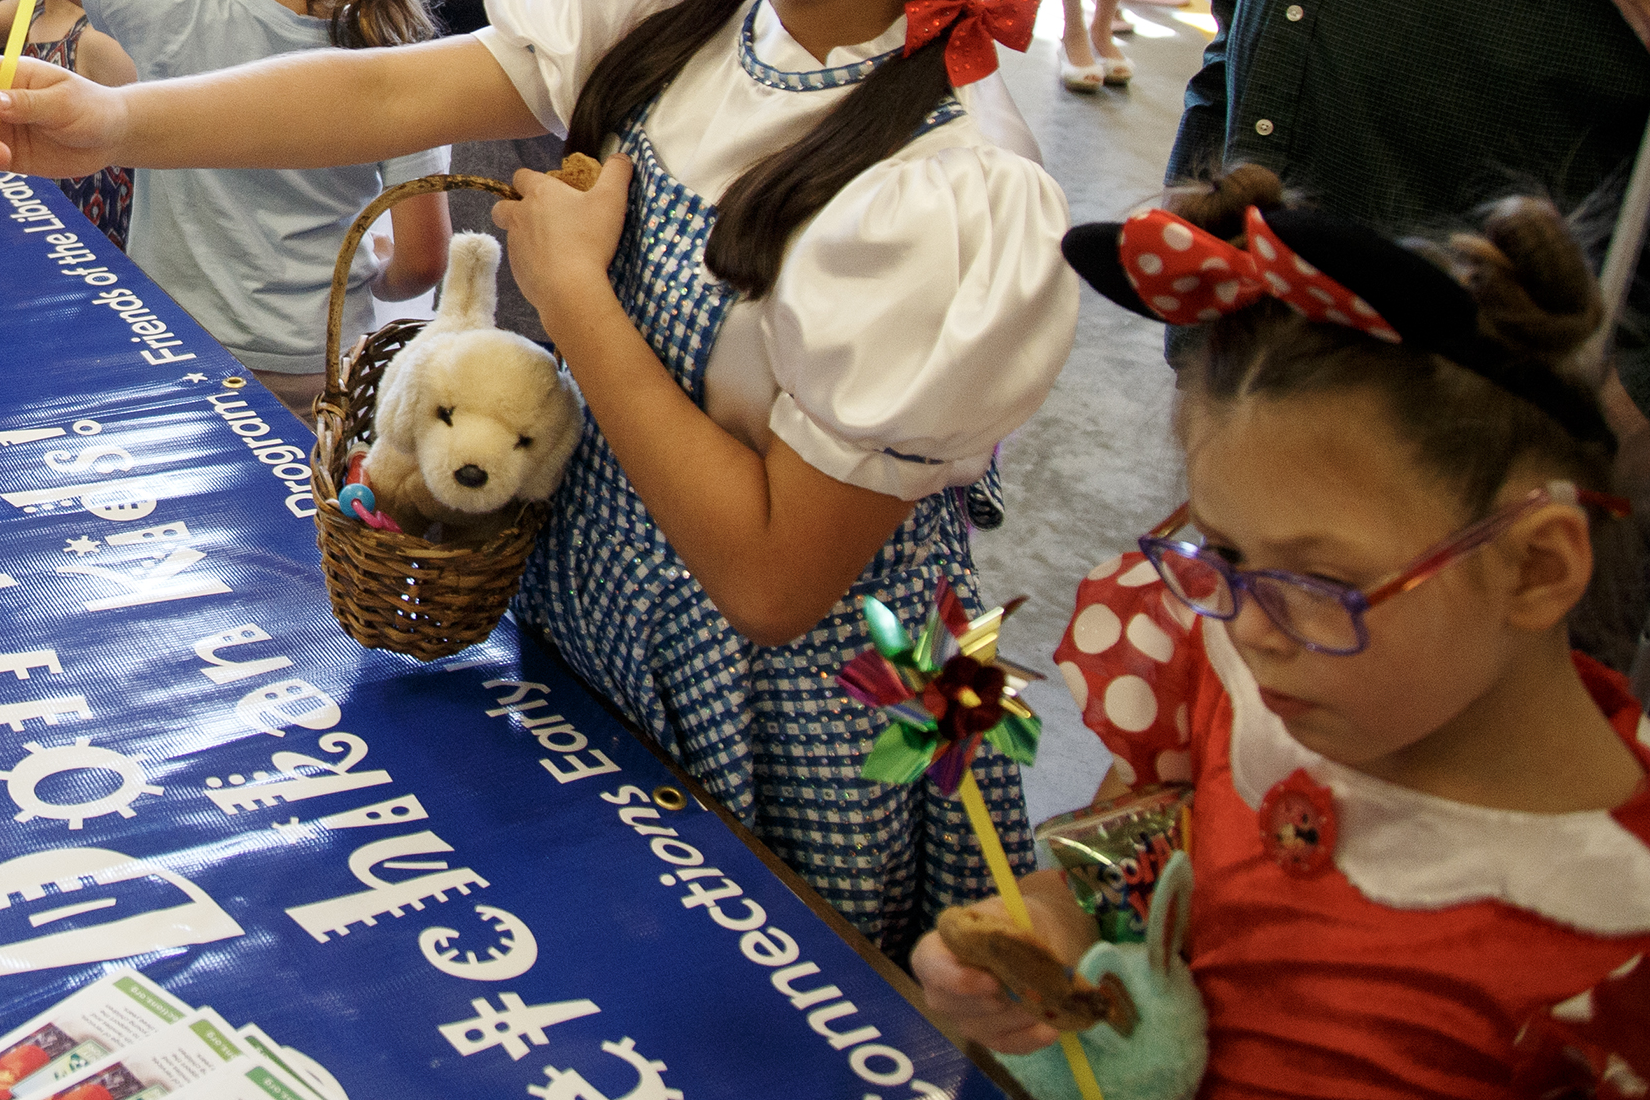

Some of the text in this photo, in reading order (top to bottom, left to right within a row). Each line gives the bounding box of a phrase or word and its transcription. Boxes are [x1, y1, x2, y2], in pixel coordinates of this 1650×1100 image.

[46, 232, 96, 265] the
[61, 266, 118, 286] of
[92, 288, 197, 365] Friends
[207, 391, 318, 519] Program
[482, 678, 622, 784] Early
[204, 622, 685, 1100] etchikan
